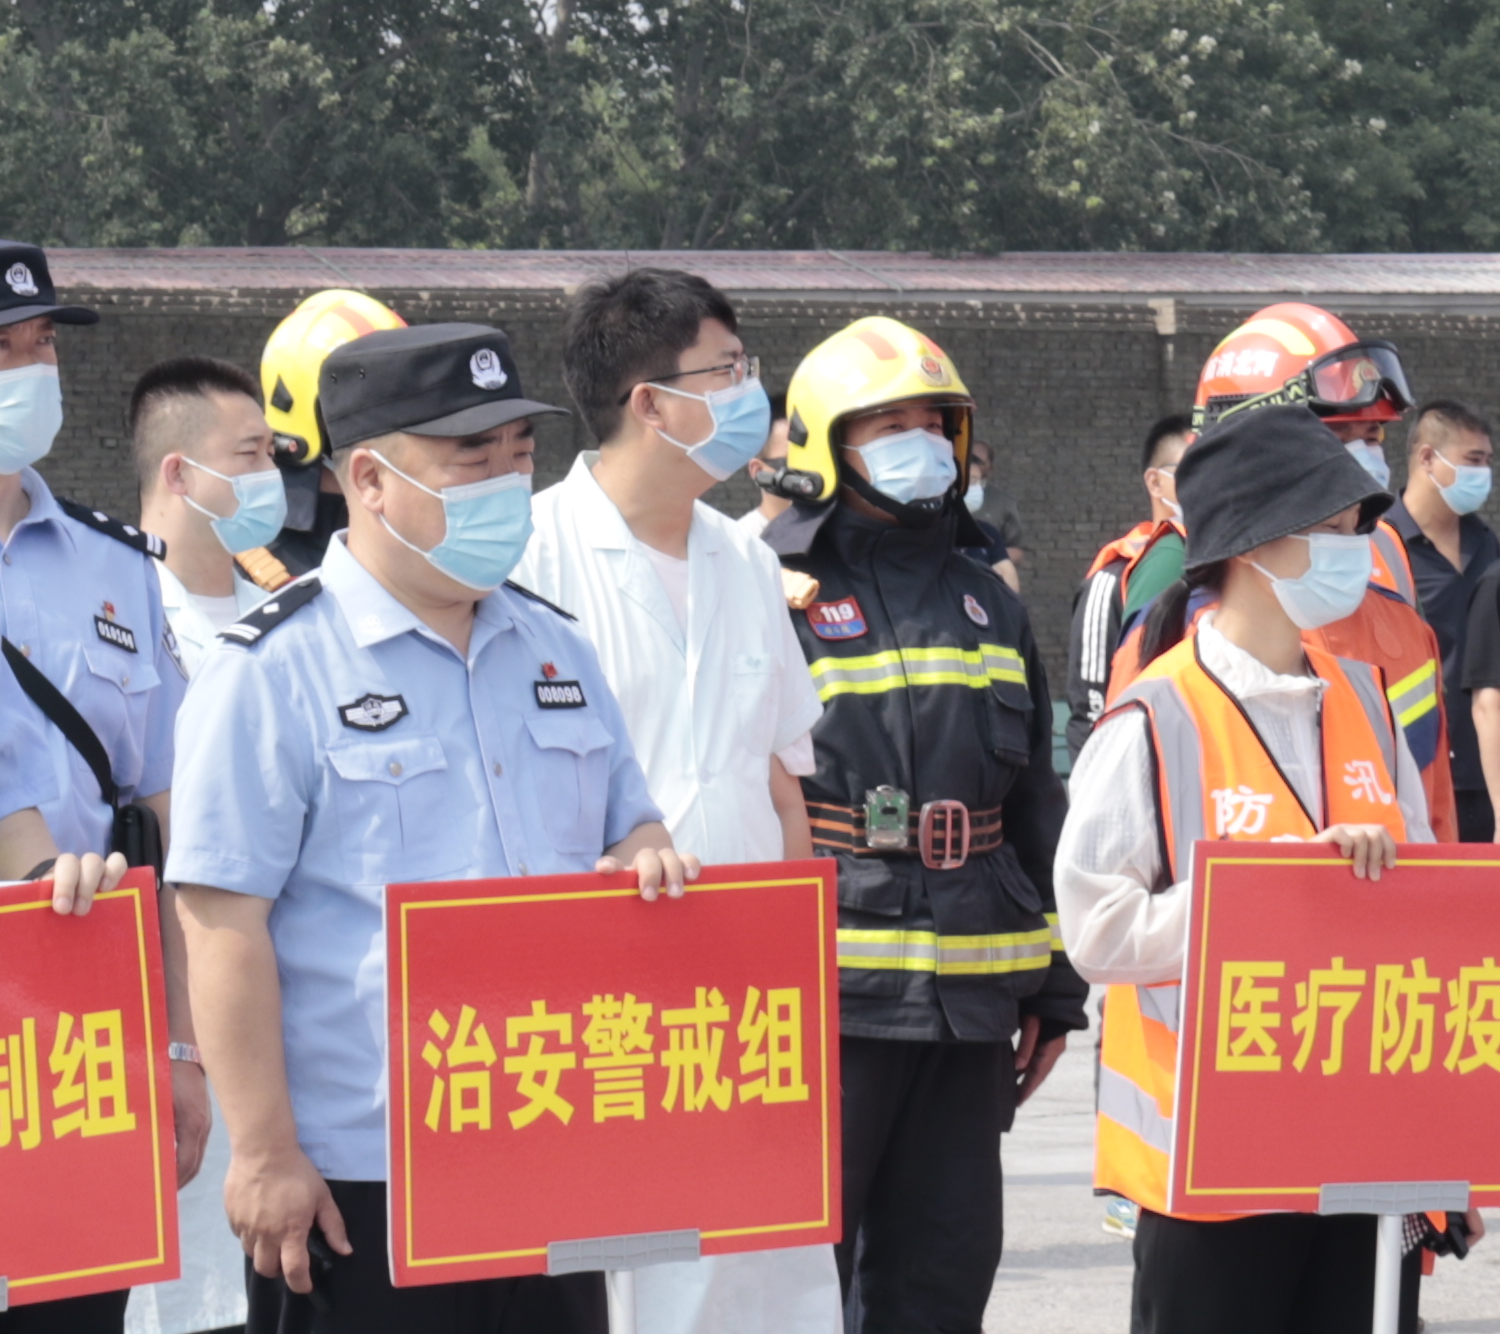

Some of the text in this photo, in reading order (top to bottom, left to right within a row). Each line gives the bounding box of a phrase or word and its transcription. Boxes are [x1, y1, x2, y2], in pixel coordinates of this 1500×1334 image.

[820, 602, 855, 623] 119
[1210, 759, 1393, 835] 防 汛
[420, 985, 809, 1133] 治安警戒组
